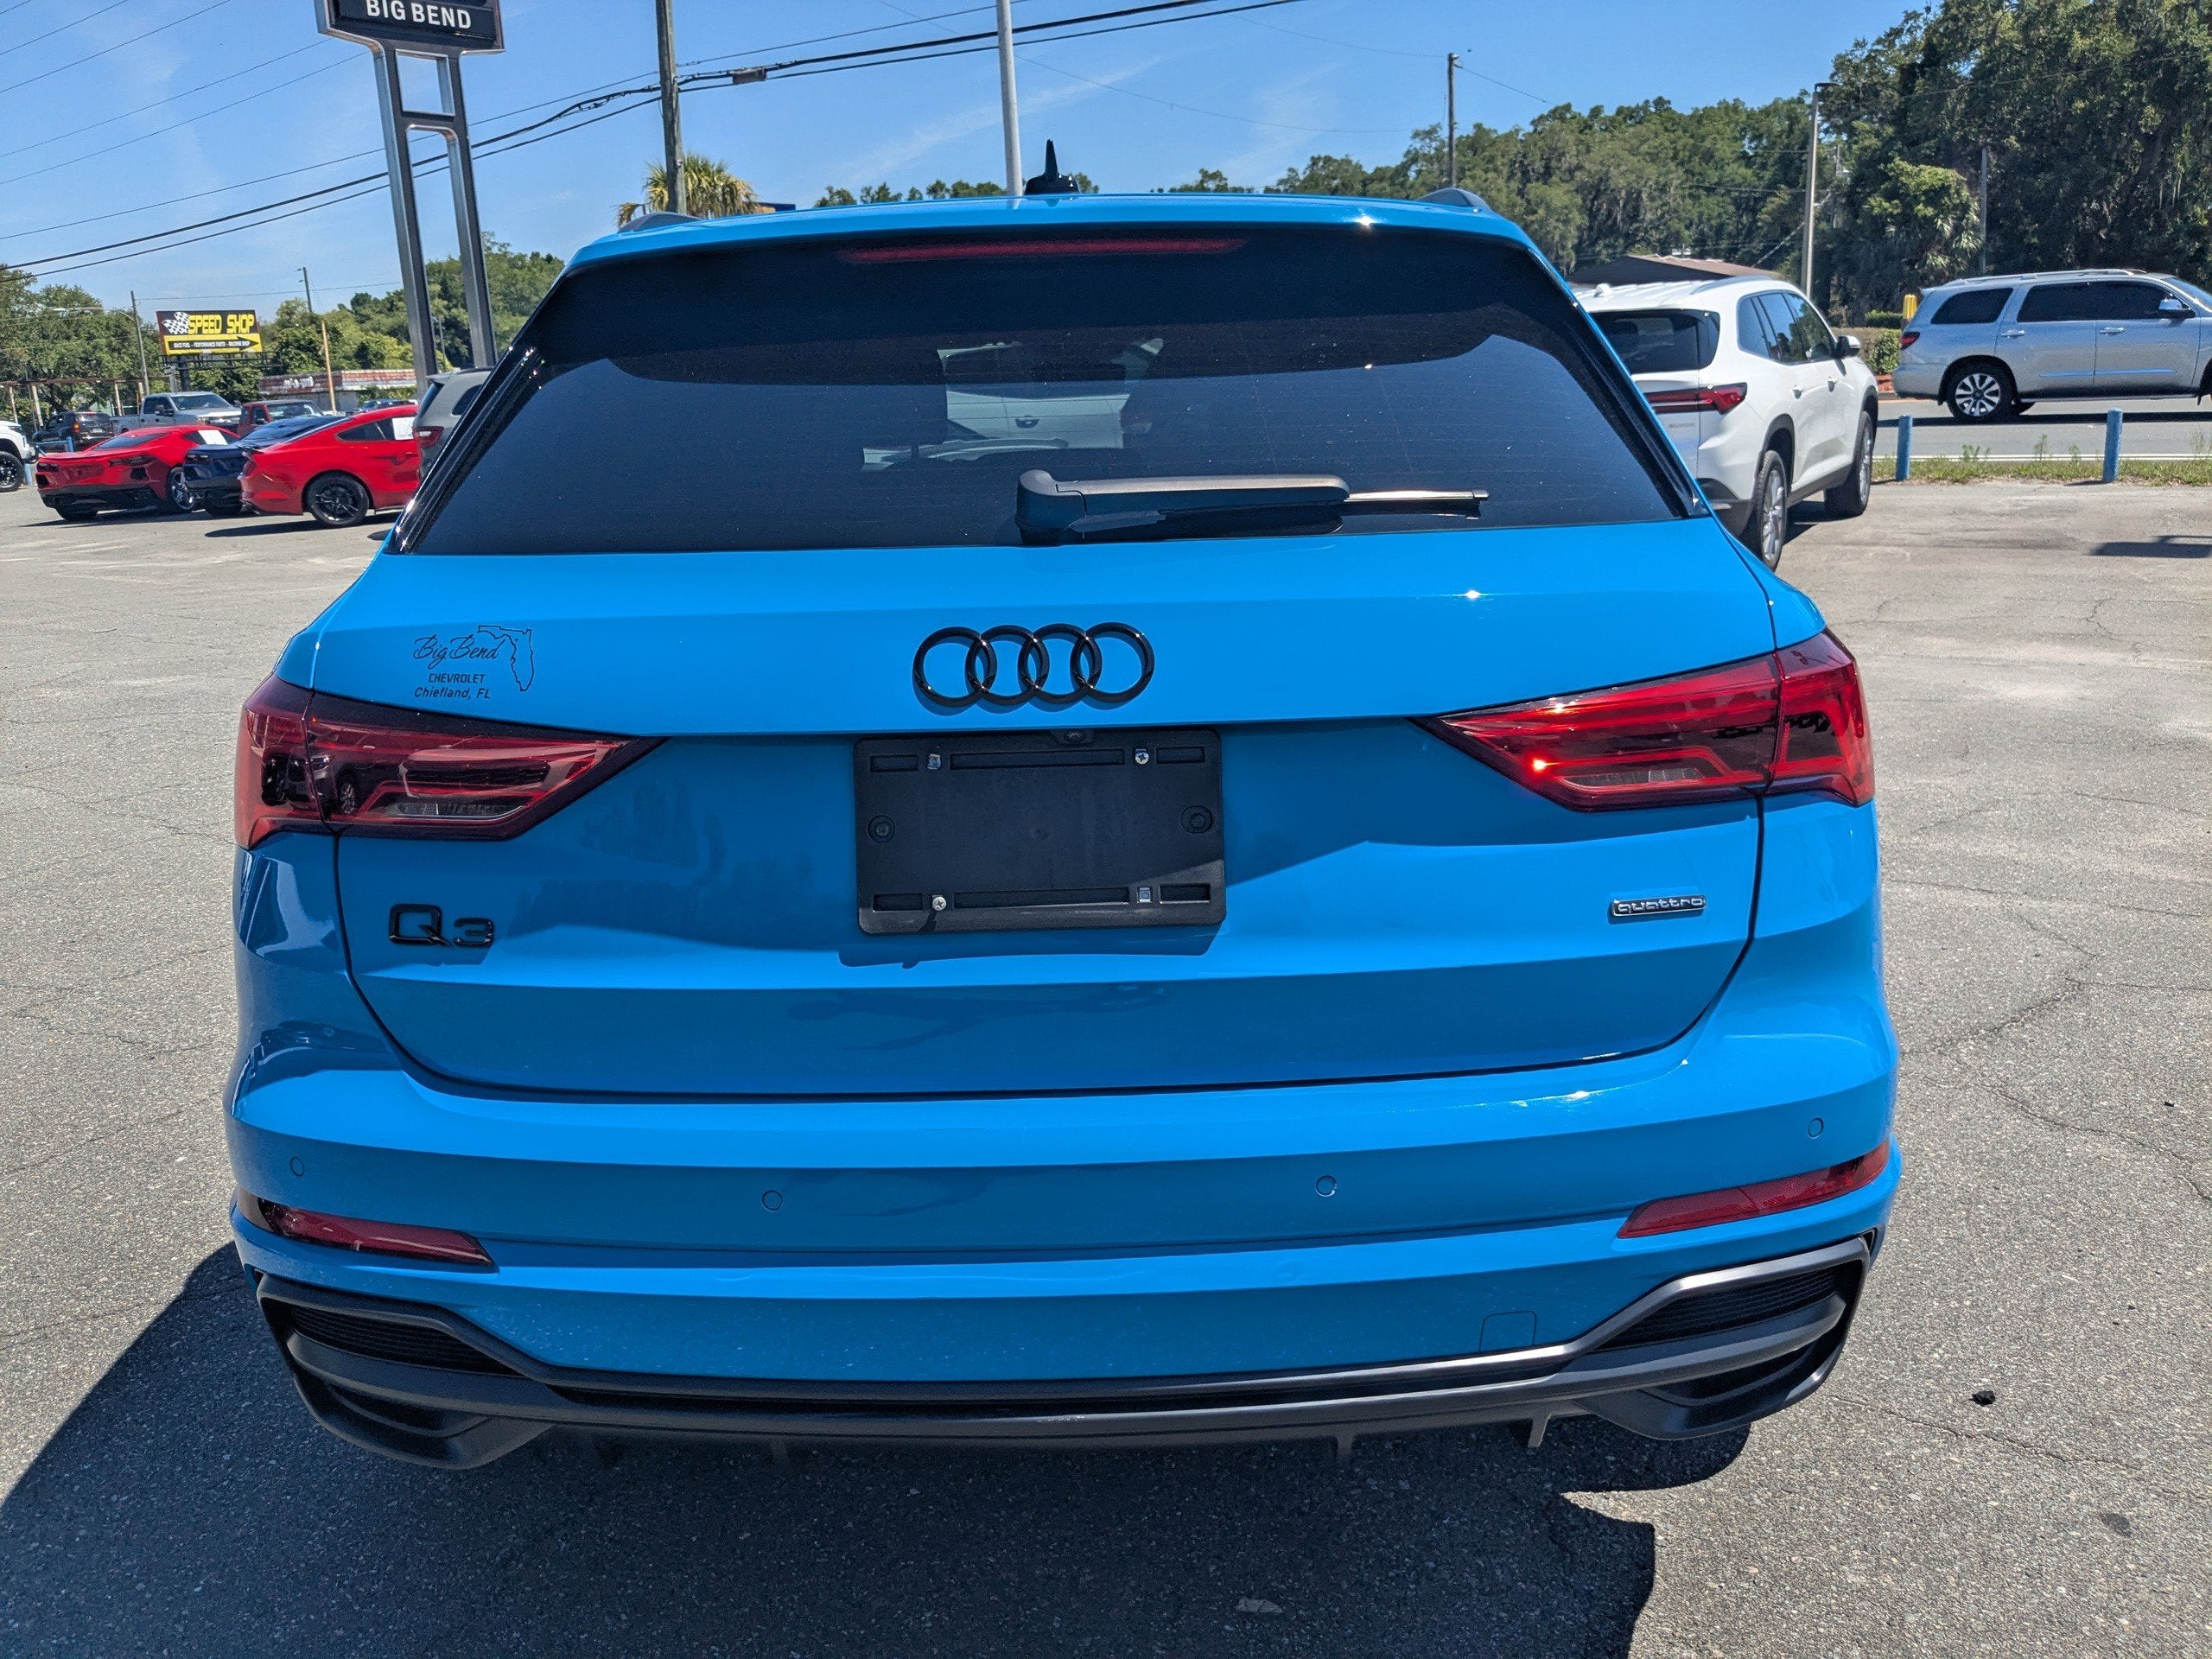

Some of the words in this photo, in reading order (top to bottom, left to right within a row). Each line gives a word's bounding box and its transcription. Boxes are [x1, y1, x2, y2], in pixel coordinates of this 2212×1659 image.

[366, 0, 406, 21] BIG
[410, 3, 472, 29] BEND
[188, 314, 222, 334] SPEED
[226, 314, 255, 334] SHOP
[413, 634, 448, 670] Big
[449, 634, 505, 659] Bend
[428, 672, 486, 683] CHEVROLET
[414, 687, 472, 700] Chiefland,
[476, 688, 491, 699] FL
[1618, 897, 1703, 914] quattro
[389, 903, 495, 948] Q3
